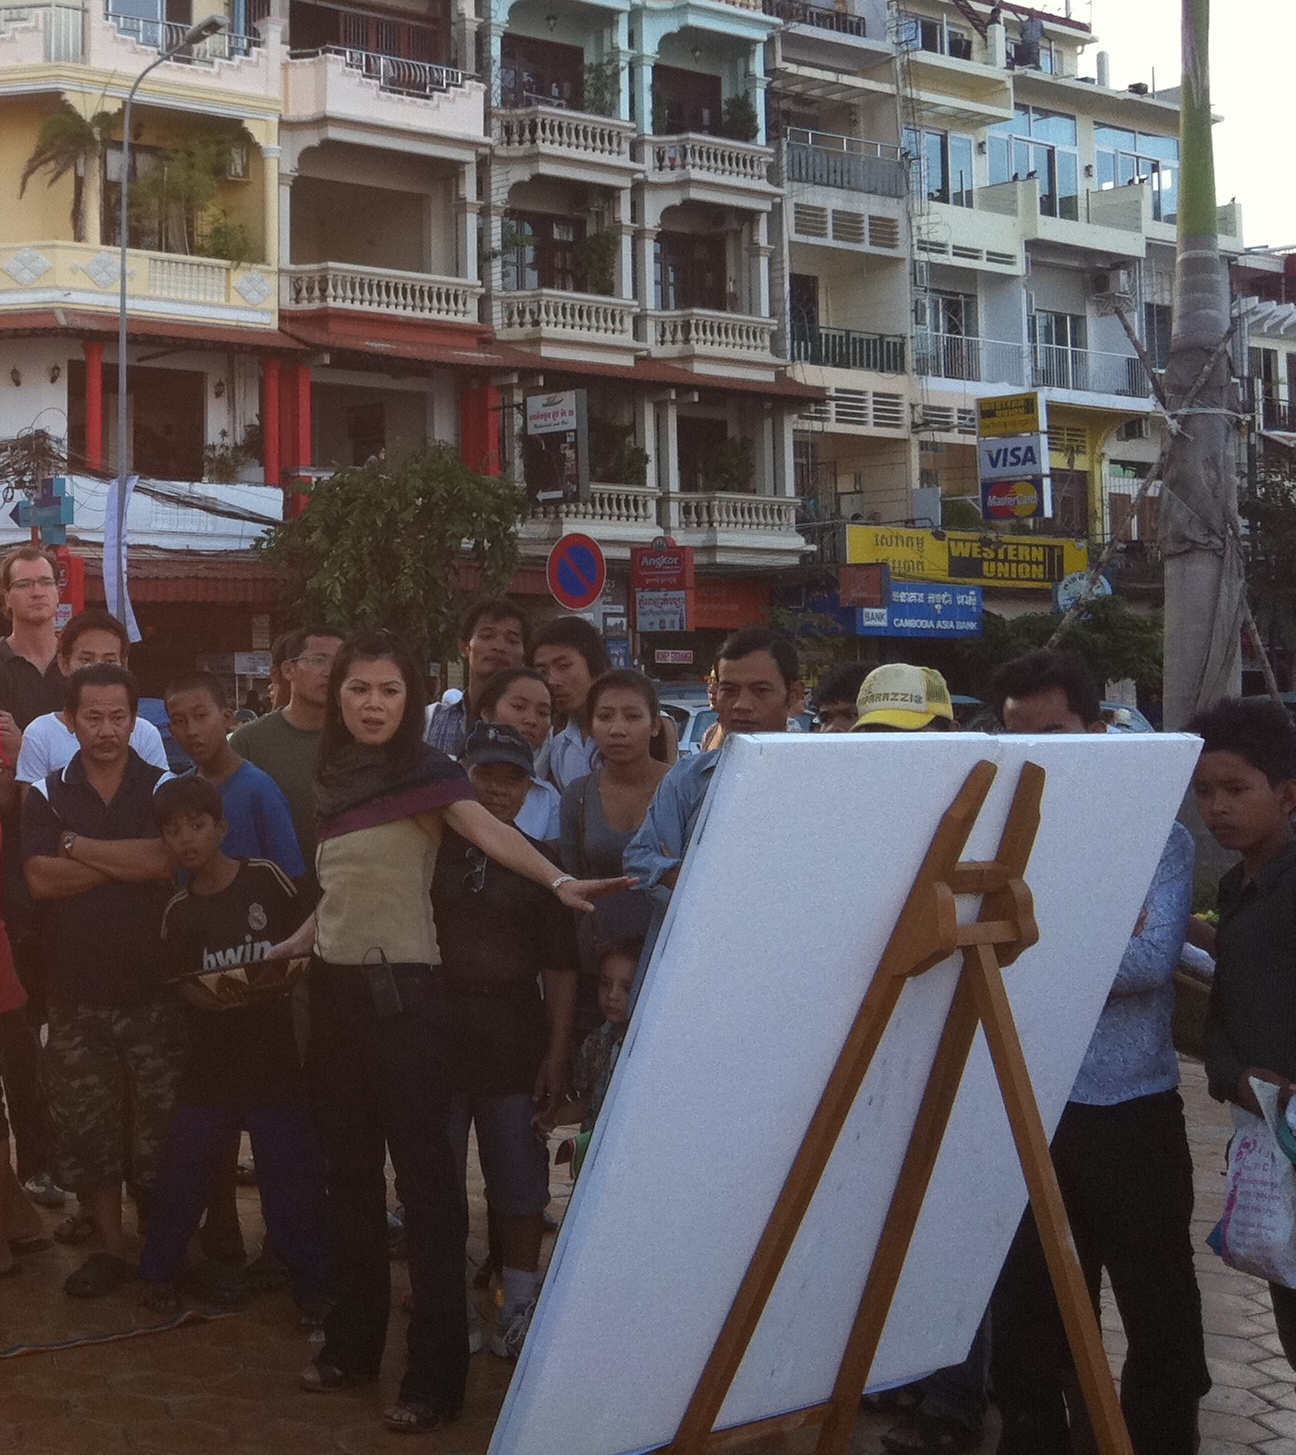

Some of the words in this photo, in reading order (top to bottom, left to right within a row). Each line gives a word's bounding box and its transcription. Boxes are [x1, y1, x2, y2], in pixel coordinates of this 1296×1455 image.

[984, 445, 1037, 469] VISA
[987, 494, 1038, 508] MasterCard
[949, 541, 1045, 562] WESTERN
[983, 560, 1045, 579] UNION
[864, 611, 886, 622] BANK
[893, 618, 935, 629] CAMBODIA
[935, 620, 955, 630] ASIA
[956, 621, 979, 631] BANK
[203, 934, 273, 971] bwin
